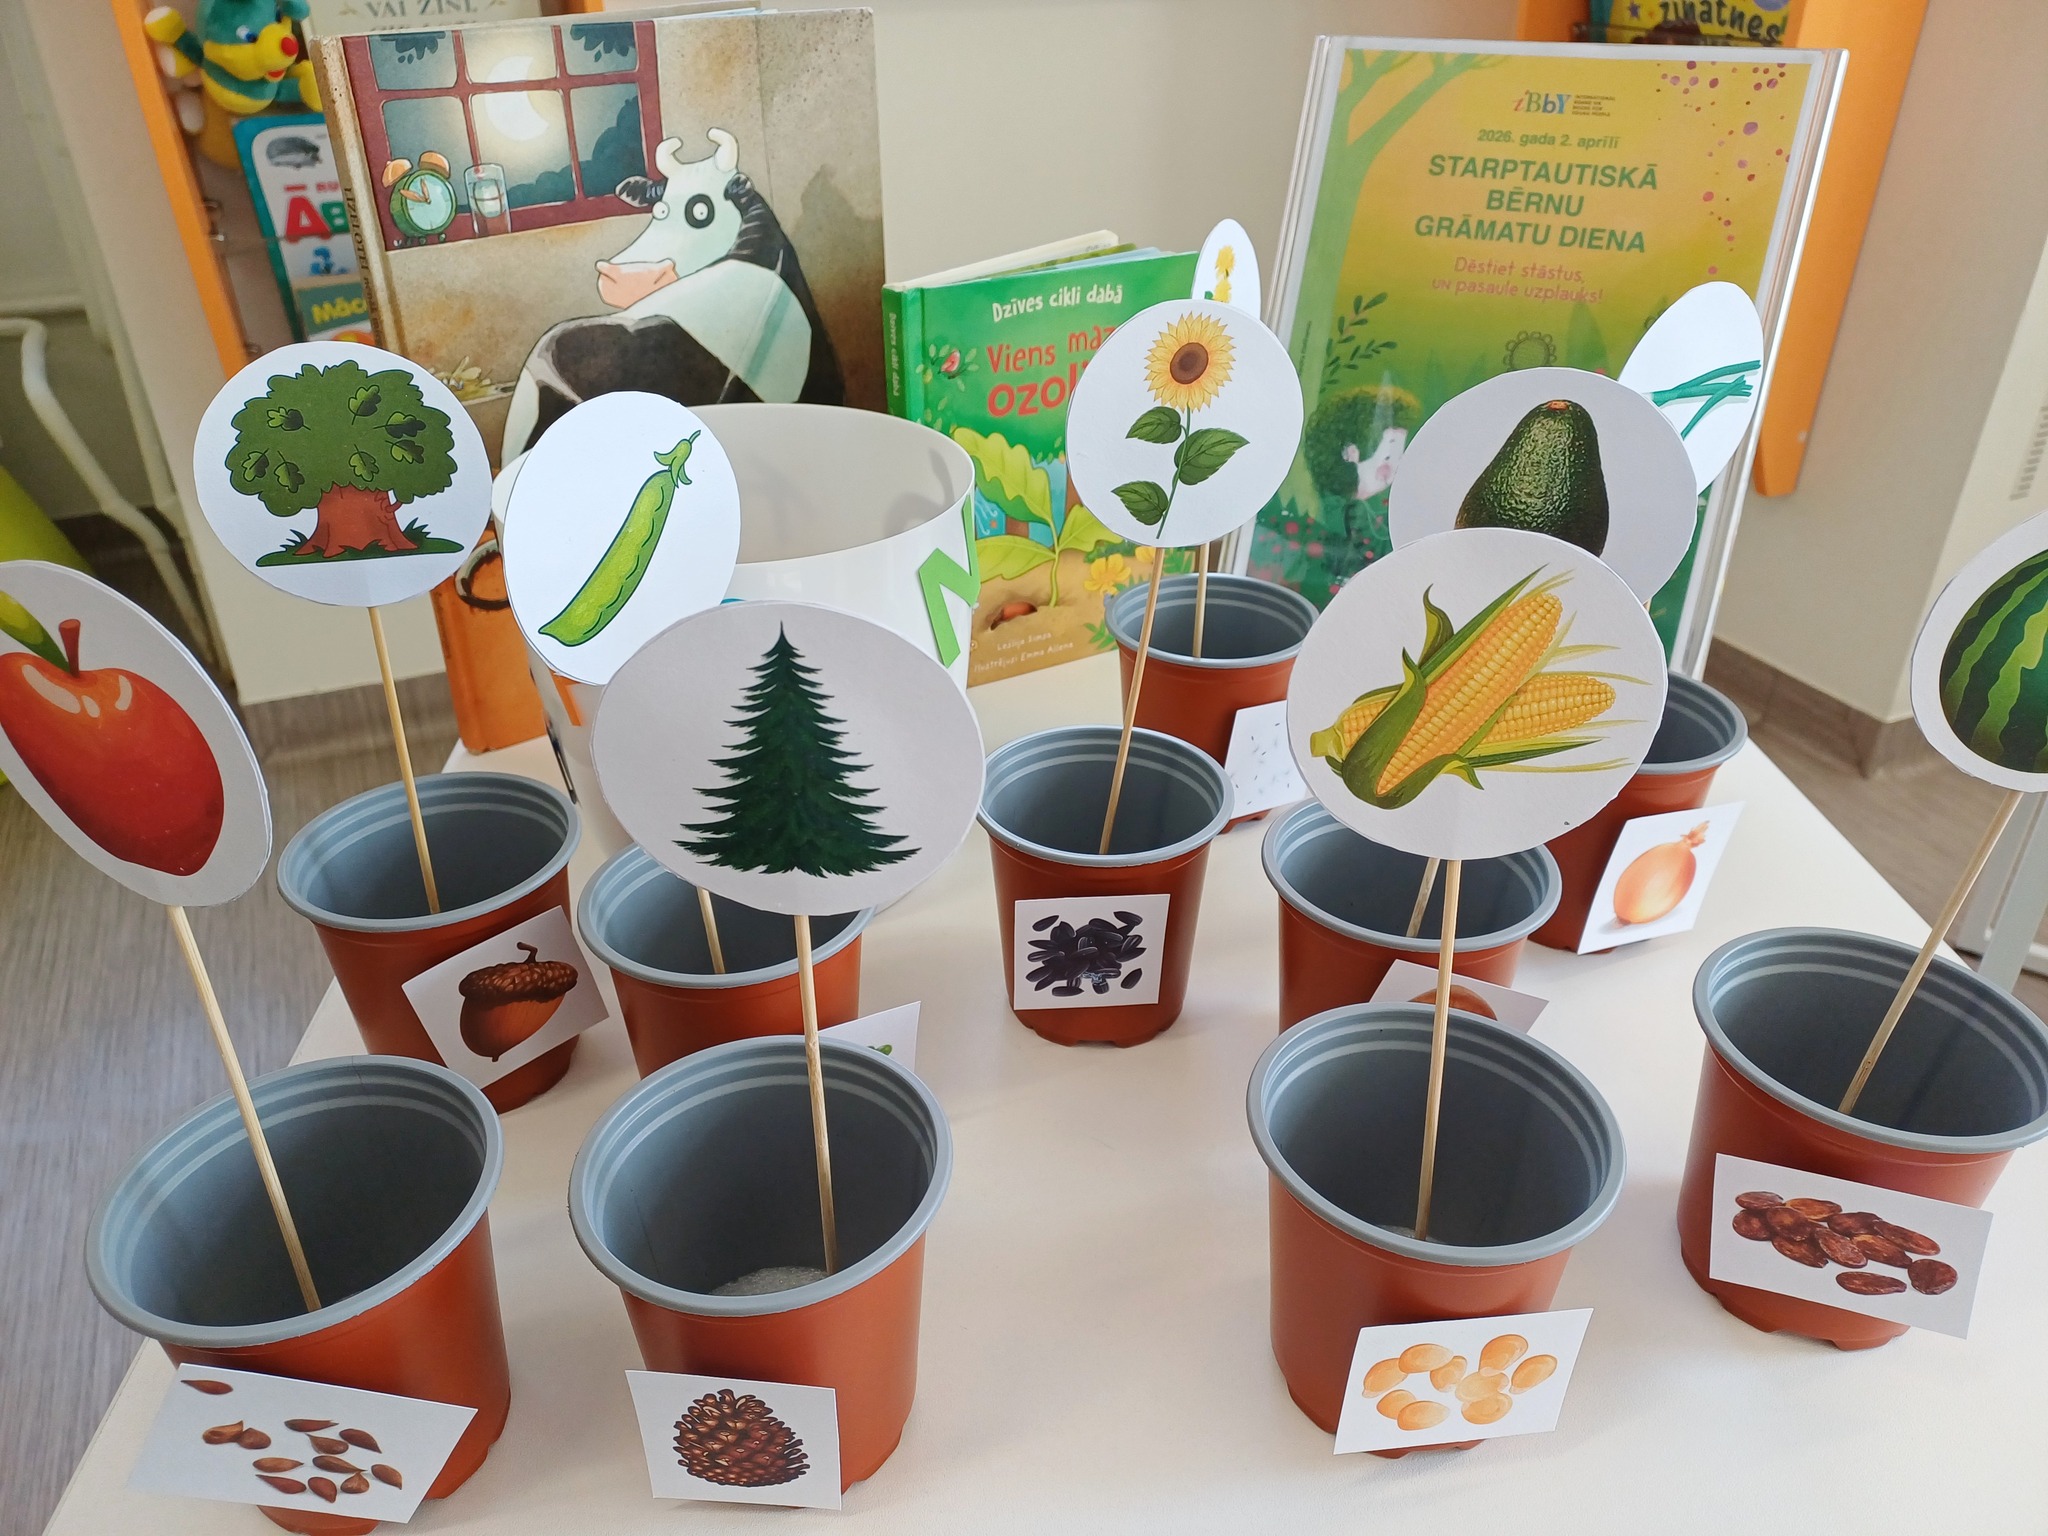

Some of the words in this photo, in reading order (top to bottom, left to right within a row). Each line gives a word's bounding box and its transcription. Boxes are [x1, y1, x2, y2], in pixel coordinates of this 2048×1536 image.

[1477, 129, 1514, 143] 2026.
[1519, 132, 1555, 147] gada
[1560, 134, 1572, 147] 2.
[1577, 135, 1621, 150] aprīlī
[1428, 154, 1658, 190] STARPTAUTISKĀ
[1486, 186, 1585, 217] BĒRNU
[1414, 214, 1551, 245] GRĀMATU
[1558, 226, 1646, 253] DIENA
[1453, 256, 1515, 276] Dēstiet
[1521, 261, 1586, 284] stāstus,
[992, 296, 1043, 323] Dzīves
[1049, 286, 1081, 307] cikli
[1086, 284, 1123, 304] dabā
[1454, 280, 1519, 296] pasaule
[1524, 287, 1604, 304] uzplauks!
[986, 344, 1056, 374] Viens
[987, 360, 1089, 418] ozol
